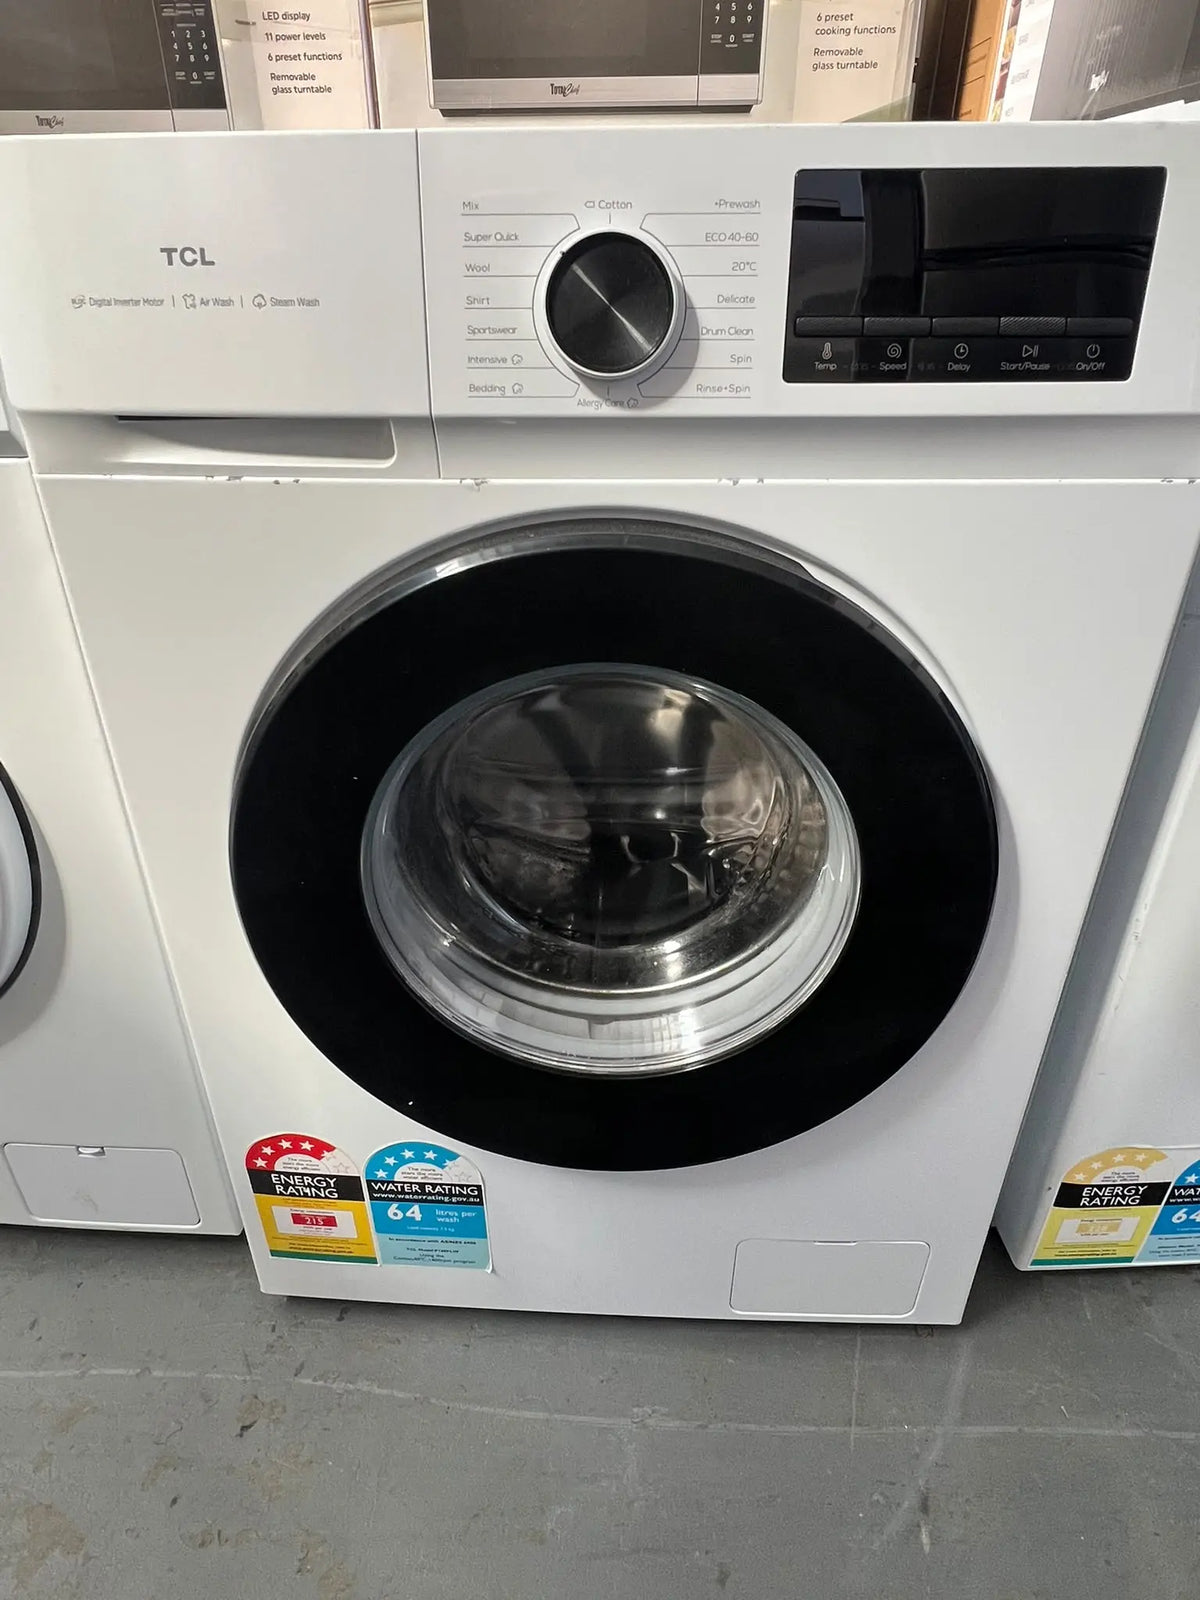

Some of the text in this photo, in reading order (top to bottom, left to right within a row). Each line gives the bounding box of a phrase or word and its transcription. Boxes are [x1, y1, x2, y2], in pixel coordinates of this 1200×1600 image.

[715, 2, 753, 11] 4 5 6
[262, 11, 311, 22] LED display
[715, 15, 752, 24] 7 8 9
[816, 13, 854, 23] 6 preset
[171, 30, 206, 38] 1 2 3
[815, 25, 897, 37] cooking functions
[264, 32, 327, 42] 11 power levels
[729, 34, 735, 43] 0
[173, 42, 208, 50] 4 5 6
[813, 47, 864, 56] Removable
[175, 54, 209, 62] 7 8 9
[267, 52, 343, 63] 6 preset functions
[812, 60, 879, 72] glass turntable
[192, 71, 198, 80] 0
[270, 72, 316, 82] Removable
[271, 85, 332, 96] glass turntable
[462, 201, 479, 210] Mix
[598, 199, 633, 209] Cotton
[463, 231, 520, 243] Super Quick
[160, 247, 215, 266] TCL
[465, 263, 490, 273] Wool
[141, 298, 165, 307] Motor
[200, 297, 235, 307] Air Wash
[270, 296, 321, 307] Steam Wash
[465, 295, 490, 305] Shirt
[716, 294, 756, 304] Delicate
[467, 325, 518, 336] Sportswear
[701, 326, 754, 336] Drum Clean
[467, 355, 508, 364] Intensive
[729, 353, 753, 365] Spin
[814, 361, 837, 371] Temp
[879, 361, 907, 371] Speed
[947, 361, 971, 372] Delay
[1000, 361, 1050, 371] Start/Pause
[1075, 361, 1105, 372] On/Off
[469, 383, 506, 396] Bedding
[577, 398, 626, 410] Allergy Care
[270, 1173, 337, 1188] ENERGY
[371, 1182, 478, 1196] WATER RATING
[1082, 1185, 1148, 1197] ENERGY
[372, 1193, 480, 1203] www.waterrating.gov.au
[1079, 1196, 1141, 1207] RATING
[387, 1203, 422, 1222] 64
[435, 1209, 459, 1218] litres
